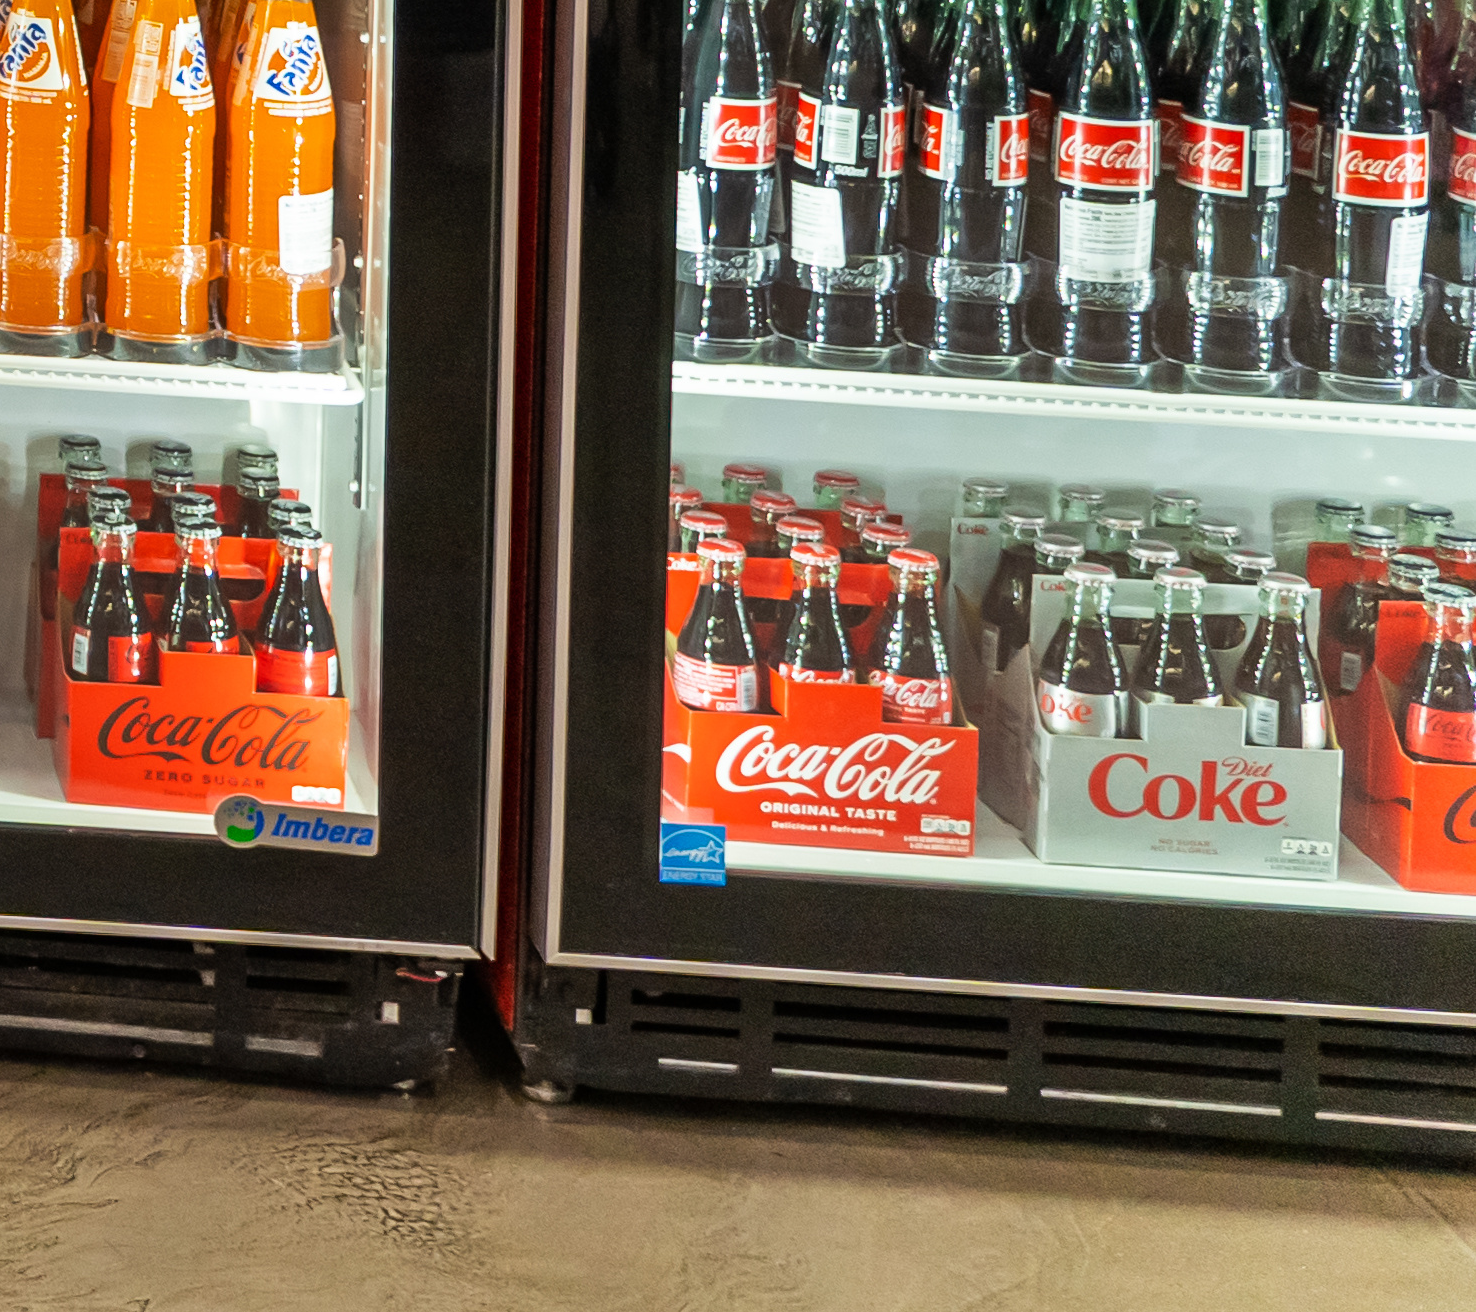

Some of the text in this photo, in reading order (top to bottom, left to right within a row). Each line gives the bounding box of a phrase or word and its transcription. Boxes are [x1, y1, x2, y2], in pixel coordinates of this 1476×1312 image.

[265, 33, 317, 96] Fanta
[1058, 134, 1150, 169] Coca-Cola
[1337, 149, 1426, 184] Coca-Cola
[97, 695, 324, 772] Coca-Cola
[144, 769, 266, 791] ZERO SUGAR
[715, 725, 956, 805] Coca-Cola
[1220, 755, 1274, 778] Diet
[1087, 751, 1290, 828] Coke
[759, 800, 898, 822] ORIGINAL TASTE
[269, 812, 375, 847] Imbera
